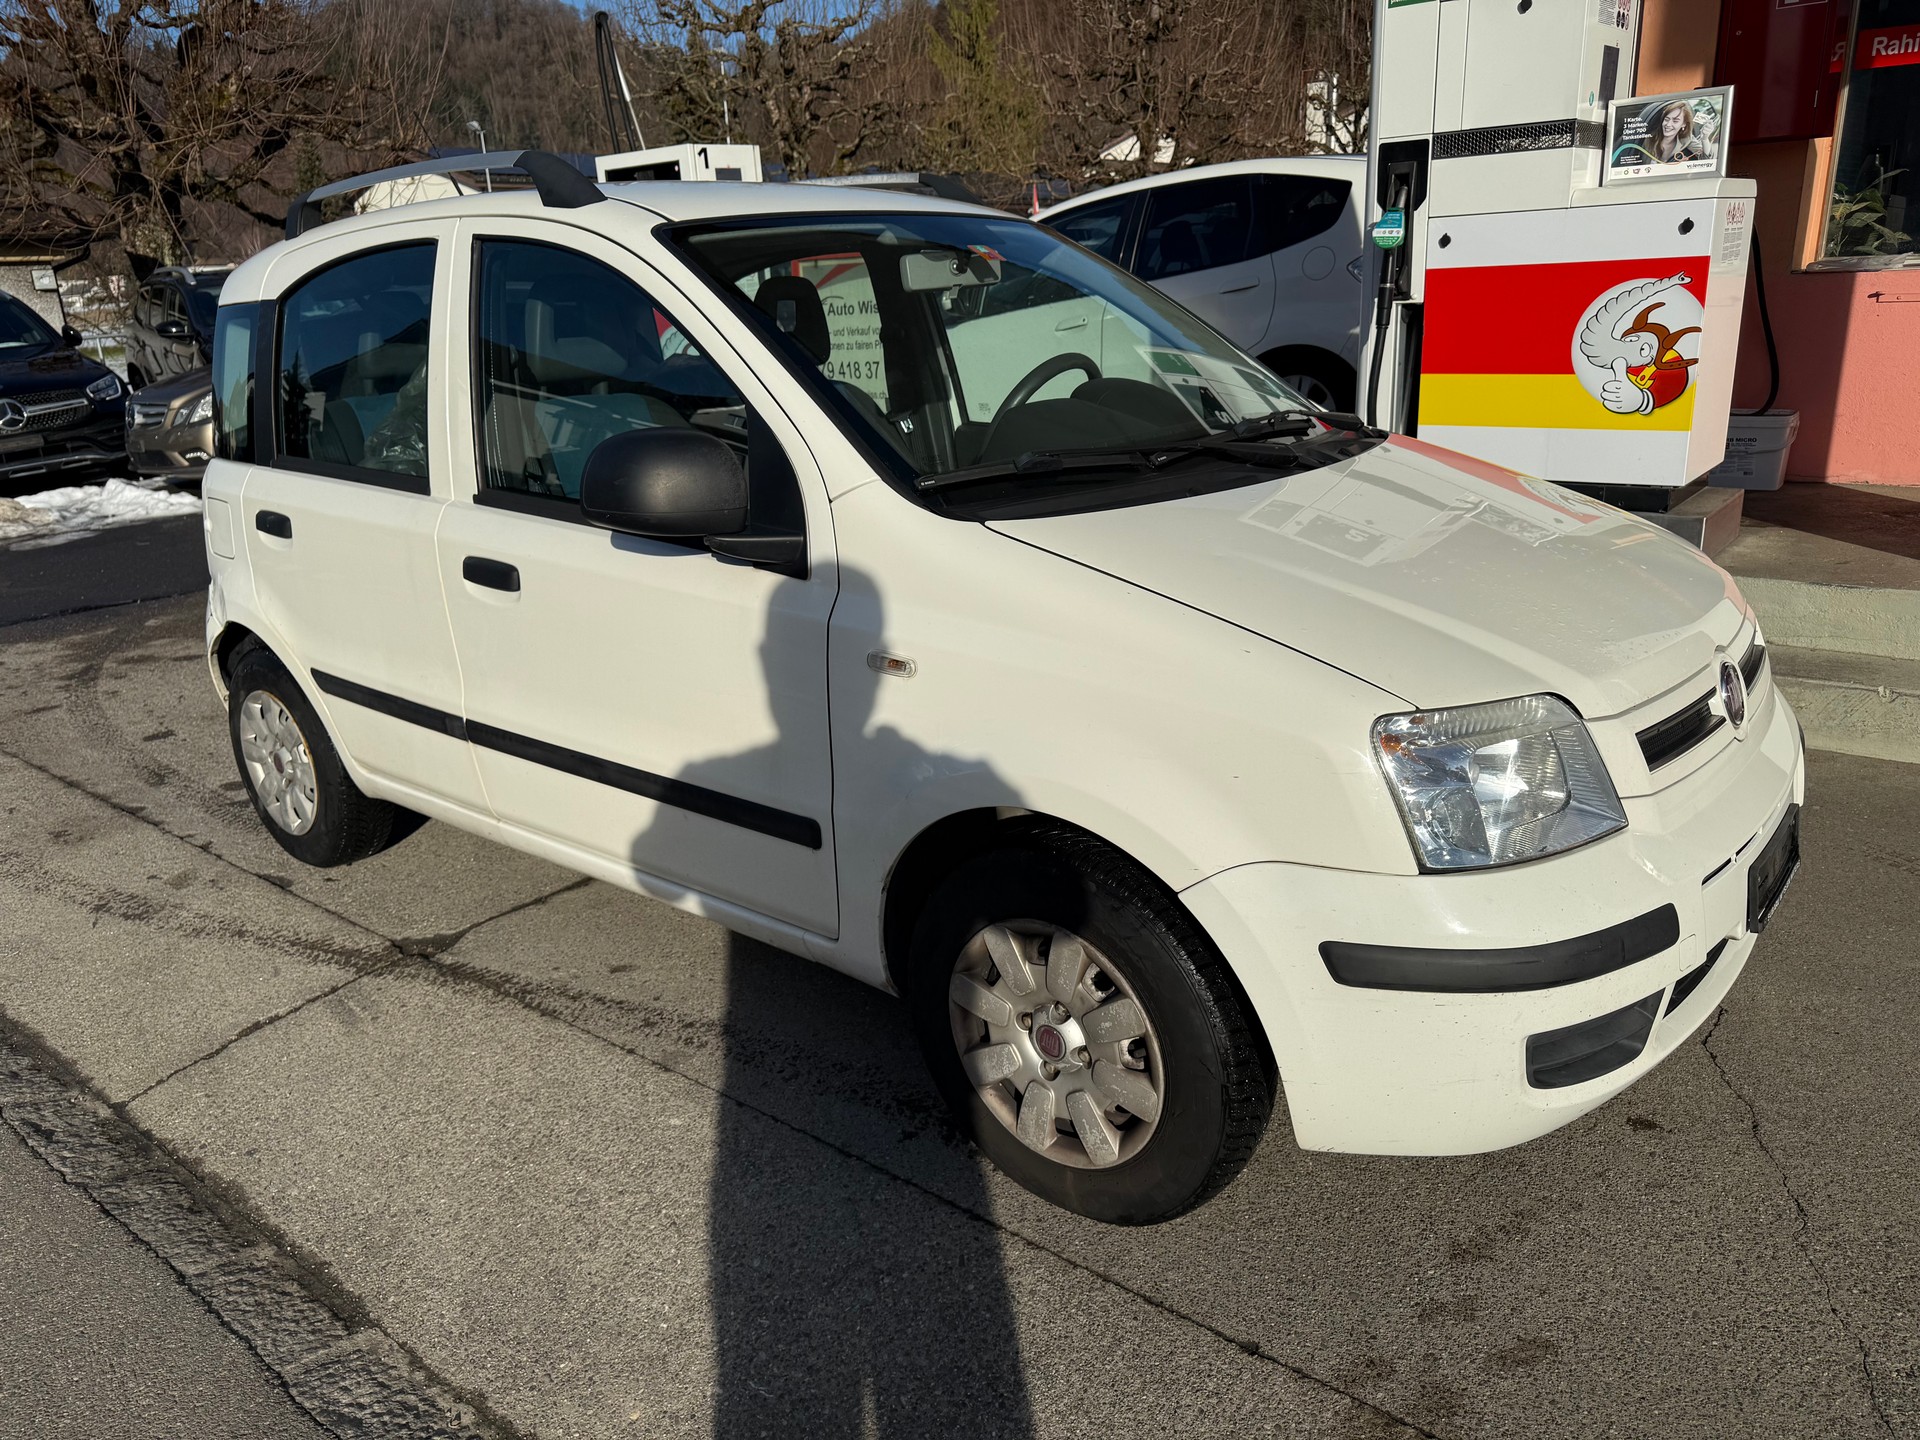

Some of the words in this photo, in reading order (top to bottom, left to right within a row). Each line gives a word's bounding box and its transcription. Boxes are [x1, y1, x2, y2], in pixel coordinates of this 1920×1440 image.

[1872, 32, 1920, 57] Rahi
[698, 147, 709, 169] 1
[827, 302, 855, 316] Auto
[833, 328, 845, 337] und
[846, 325, 871, 336] Verkauf
[846, 342, 854, 350] zu
[855, 340, 873, 350] fairen
[839, 361, 862, 380] 418
[865, 361, 880, 380] 37
